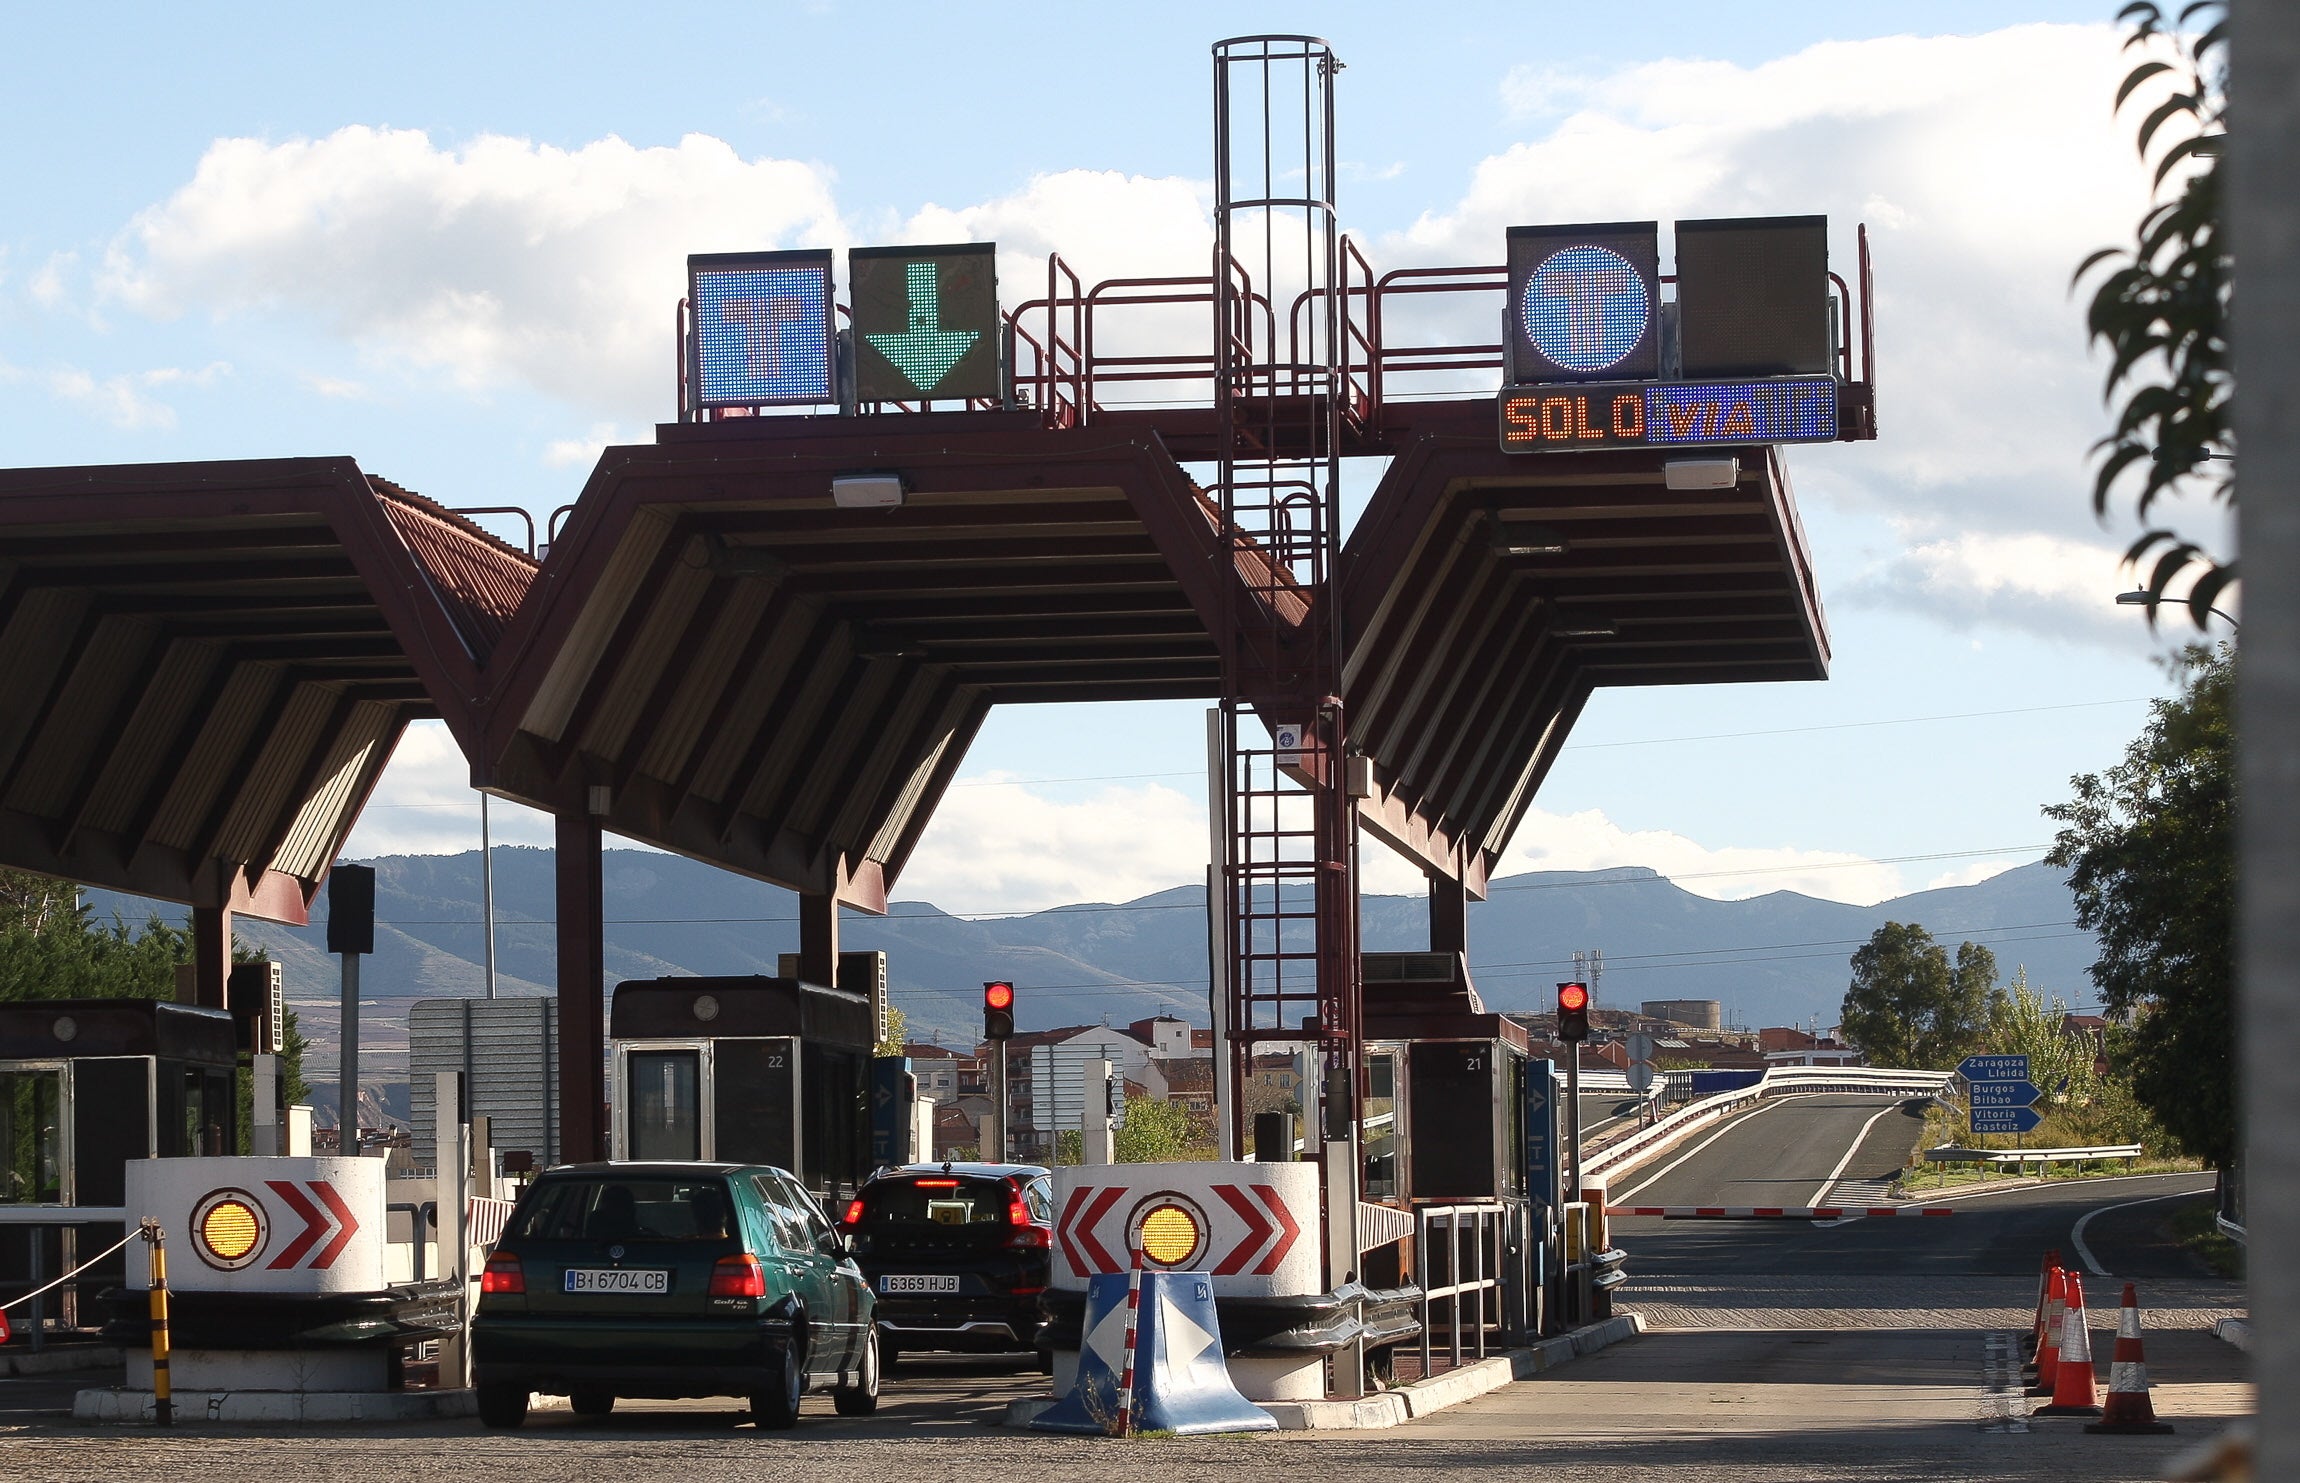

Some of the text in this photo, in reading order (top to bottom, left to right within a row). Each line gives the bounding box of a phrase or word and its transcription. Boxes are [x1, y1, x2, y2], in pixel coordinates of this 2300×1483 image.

[1505, 394, 1644, 441] SOLO
[1667, 401, 1755, 437] VIA
[768, 1055, 783, 1068] 22
[1467, 1057, 1481, 1070] 21
[1969, 1058, 2024, 1069] Zaragoza
[1988, 1068, 2024, 1078] Lleida
[1973, 1084, 2015, 1095] Burgos
[1973, 1095, 2011, 1104] Bilbao
[1974, 1109, 2016, 1119] Vitoria
[1974, 1121, 2019, 1131] Gasteiz
[598, 1272, 639, 1289] 6704
[644, 1273, 665, 1290] CB
[890, 1277, 956, 1291] 6369 HJB
